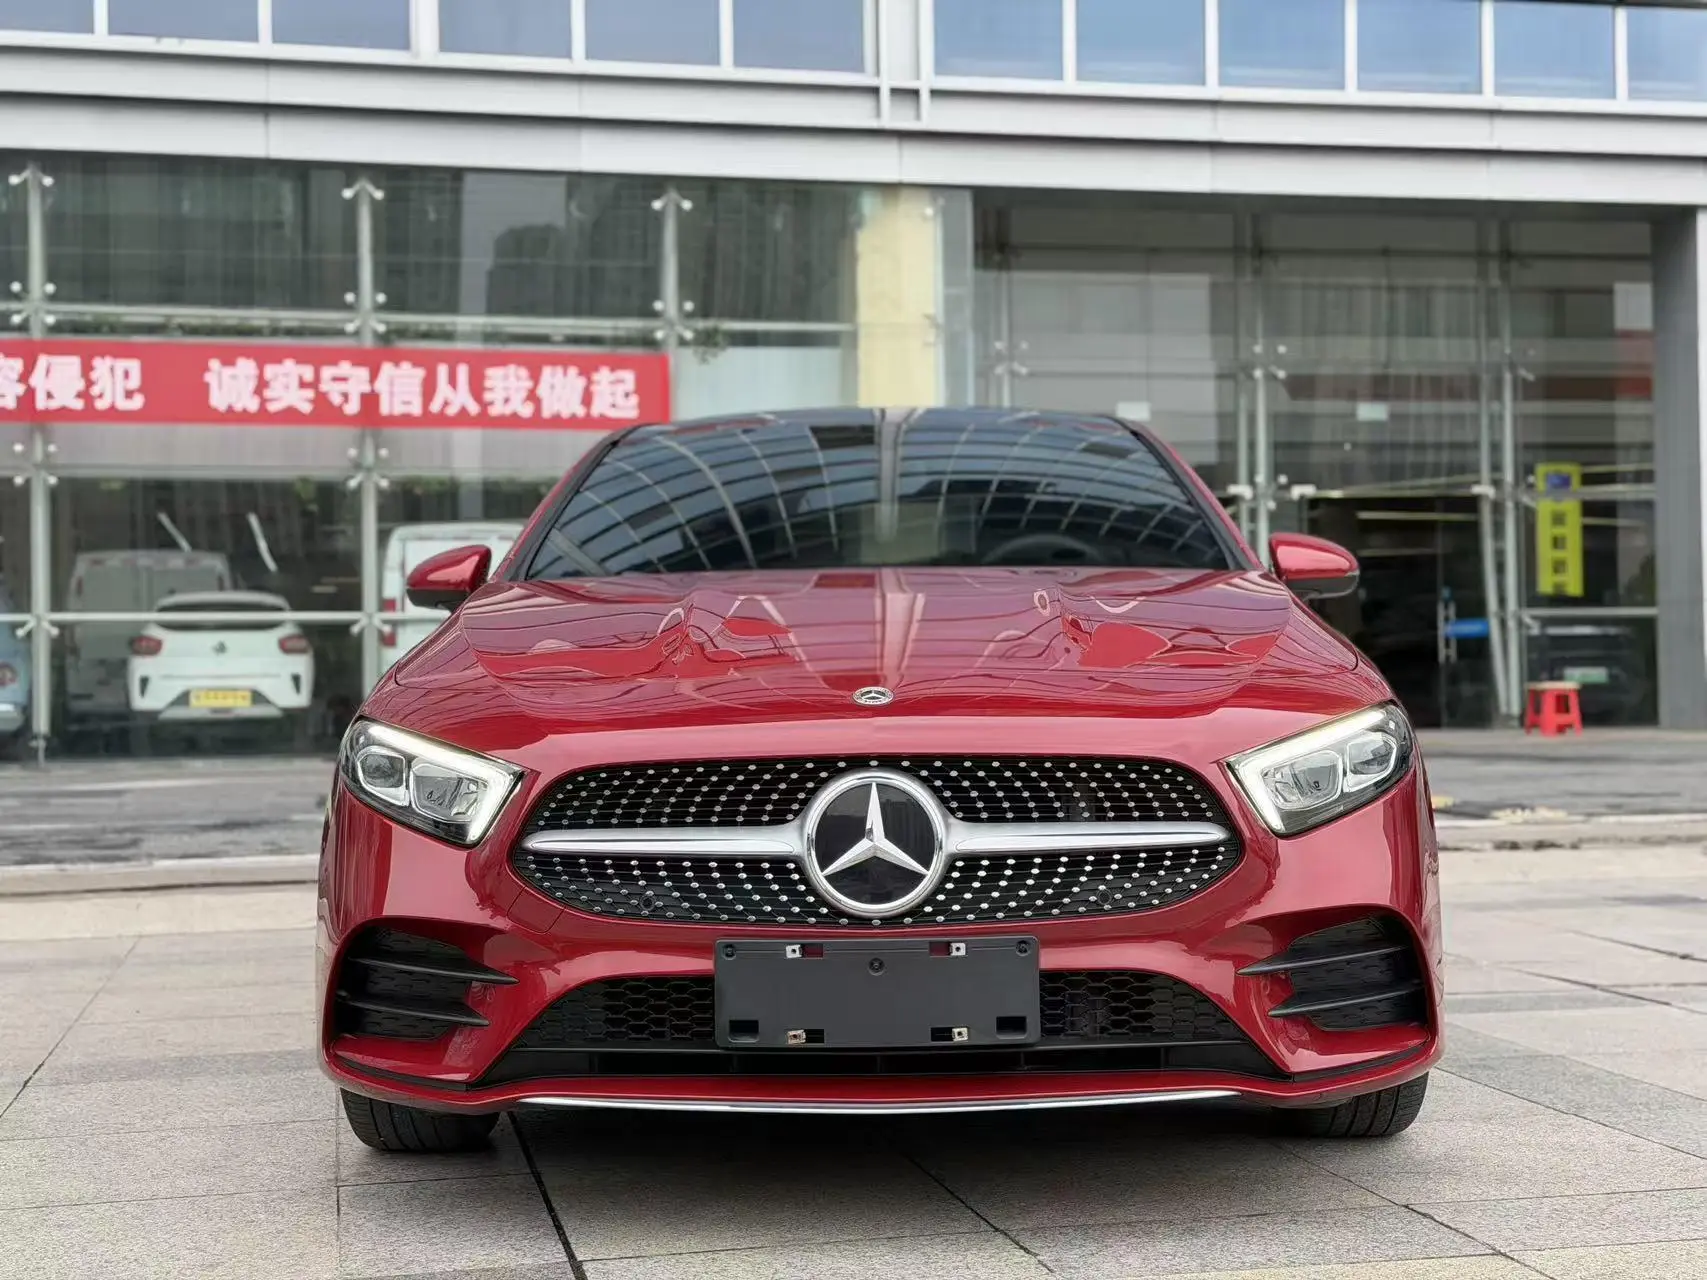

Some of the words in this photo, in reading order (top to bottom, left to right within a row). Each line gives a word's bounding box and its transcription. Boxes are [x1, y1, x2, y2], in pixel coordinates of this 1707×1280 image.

[203, 357, 640, 419] 诚实守信从我做起
